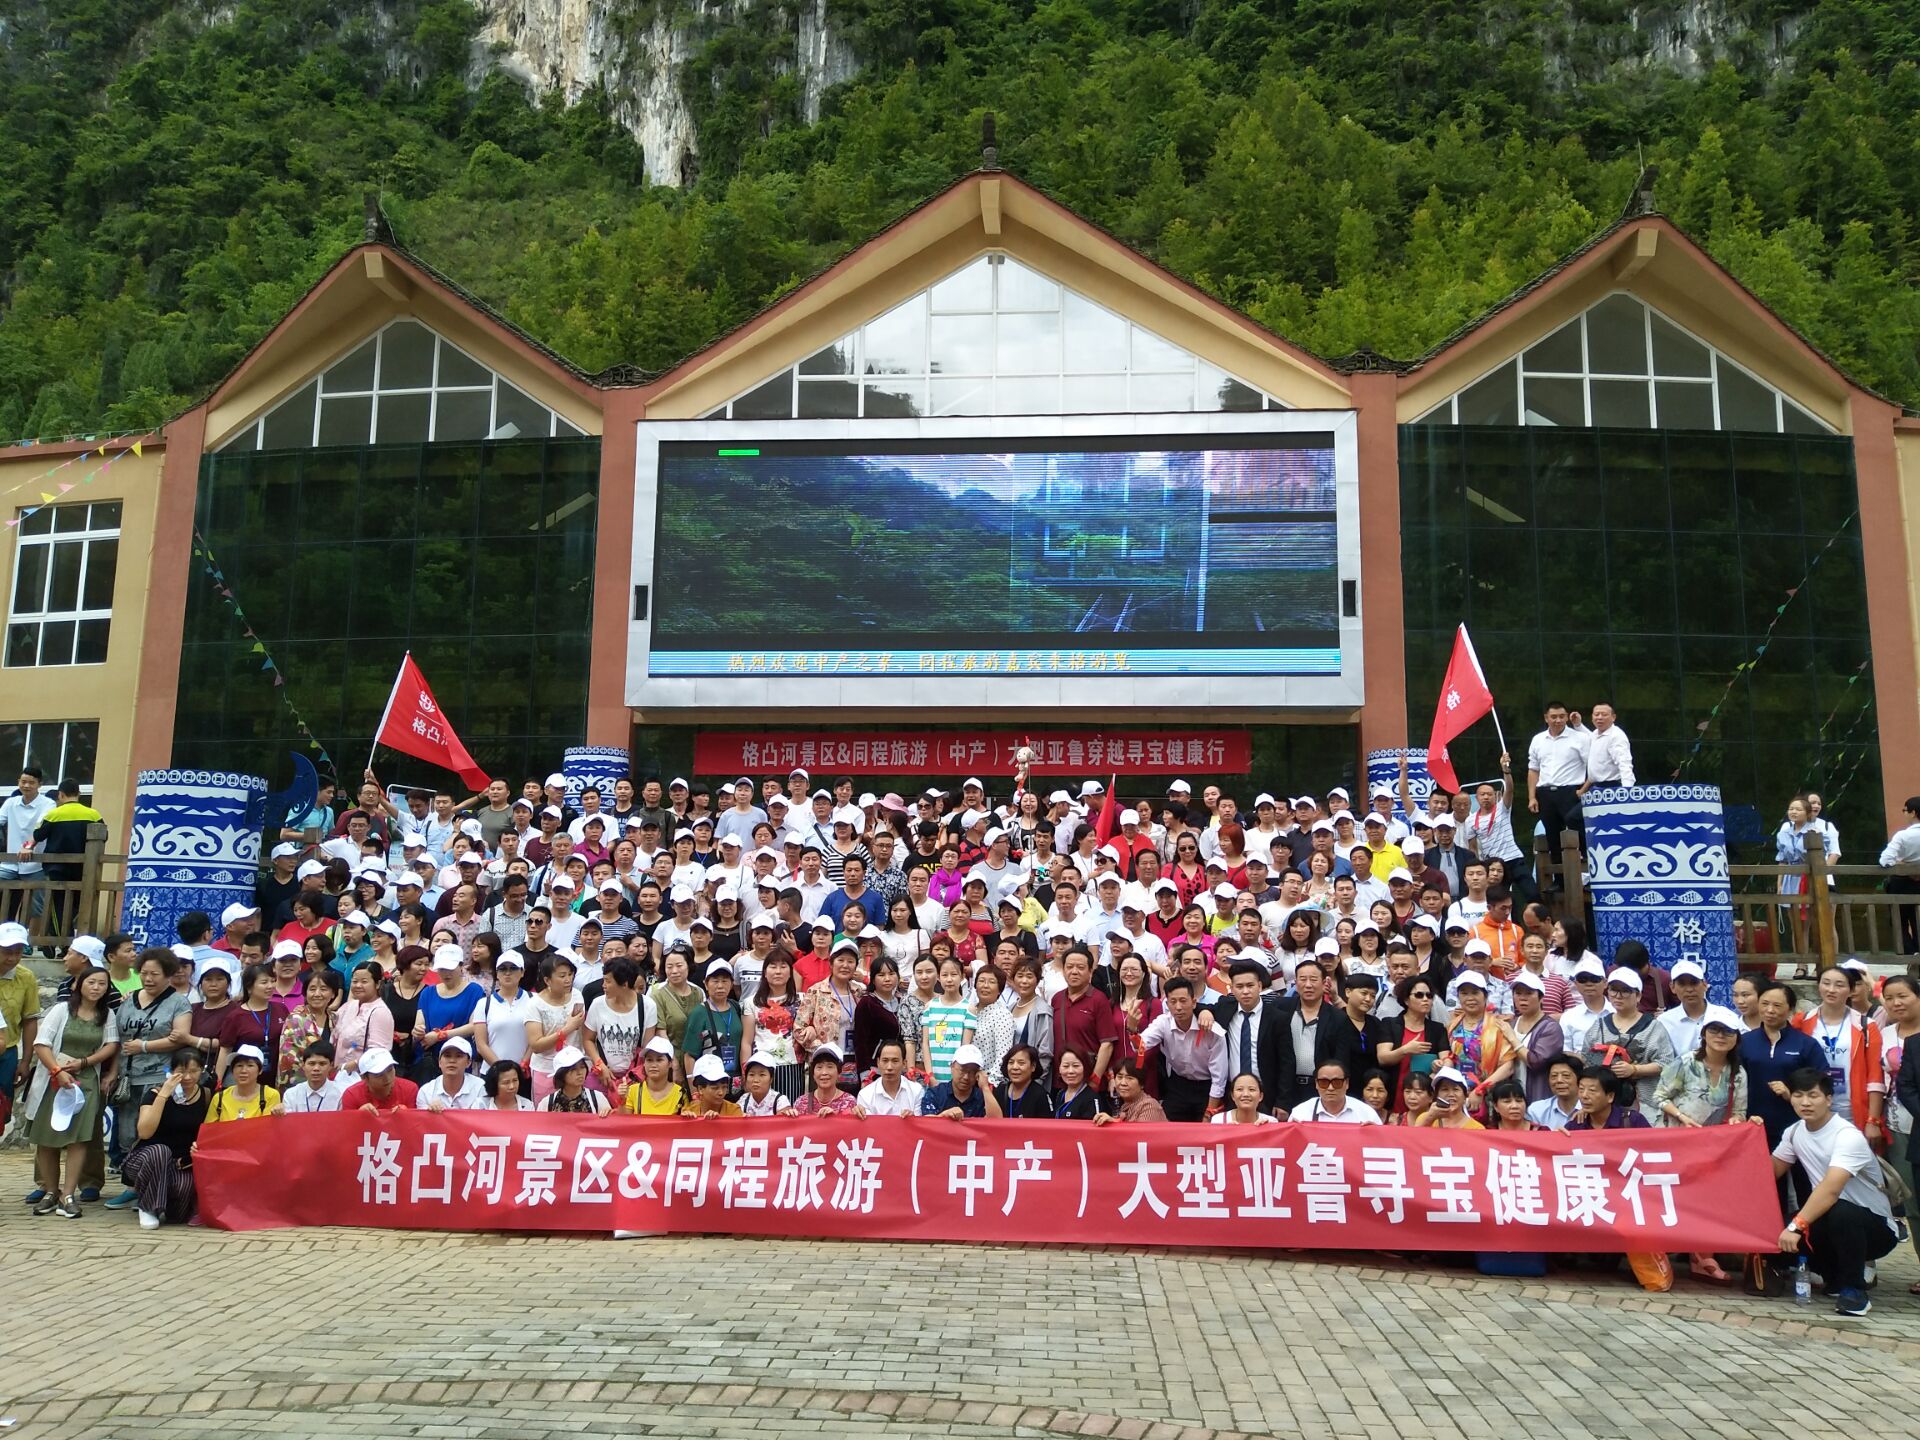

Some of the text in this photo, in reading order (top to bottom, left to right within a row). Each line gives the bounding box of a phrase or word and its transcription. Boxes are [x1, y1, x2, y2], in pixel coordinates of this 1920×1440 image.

[356, 1131, 1681, 1227] 格凸河景区&同程旅游（中产）大型亚鲁寻宝健康行
